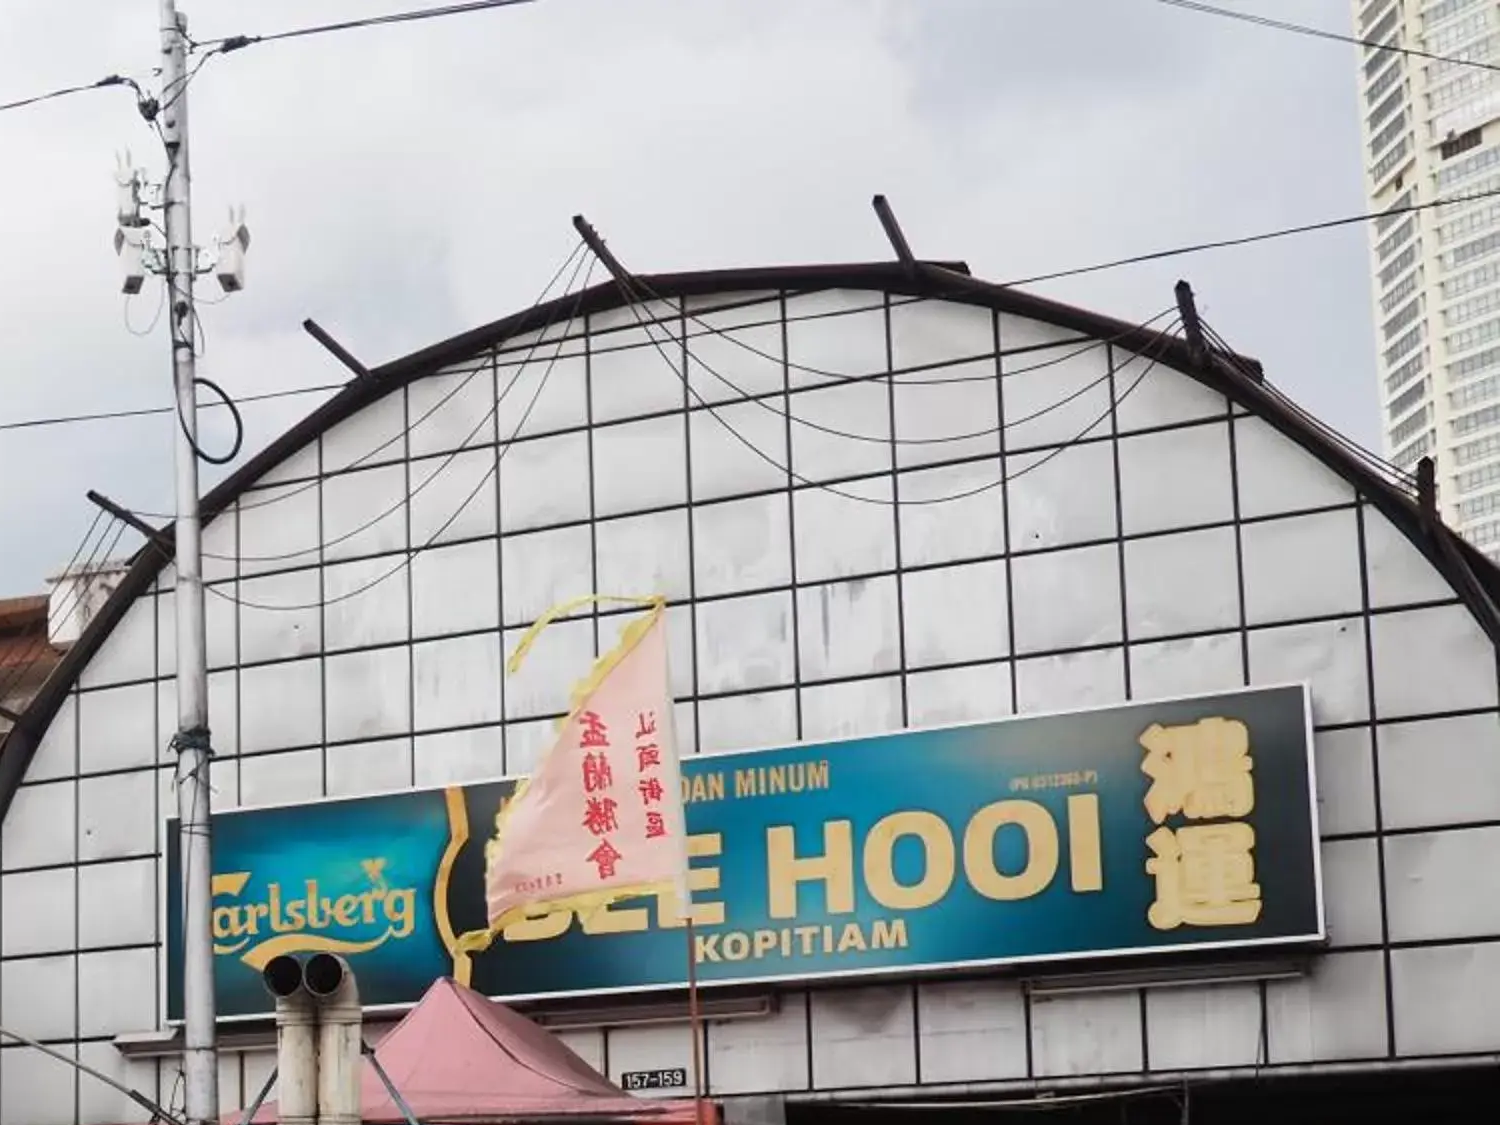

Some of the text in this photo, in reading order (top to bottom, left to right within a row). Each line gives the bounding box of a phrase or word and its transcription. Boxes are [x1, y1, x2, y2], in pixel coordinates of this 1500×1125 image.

[735, 759, 830, 798] MINUM
[766, 793, 1103, 920] HOOI
[695, 919, 908, 963] KOPITIAM
[625, 1071, 684, 1089] 157-159
